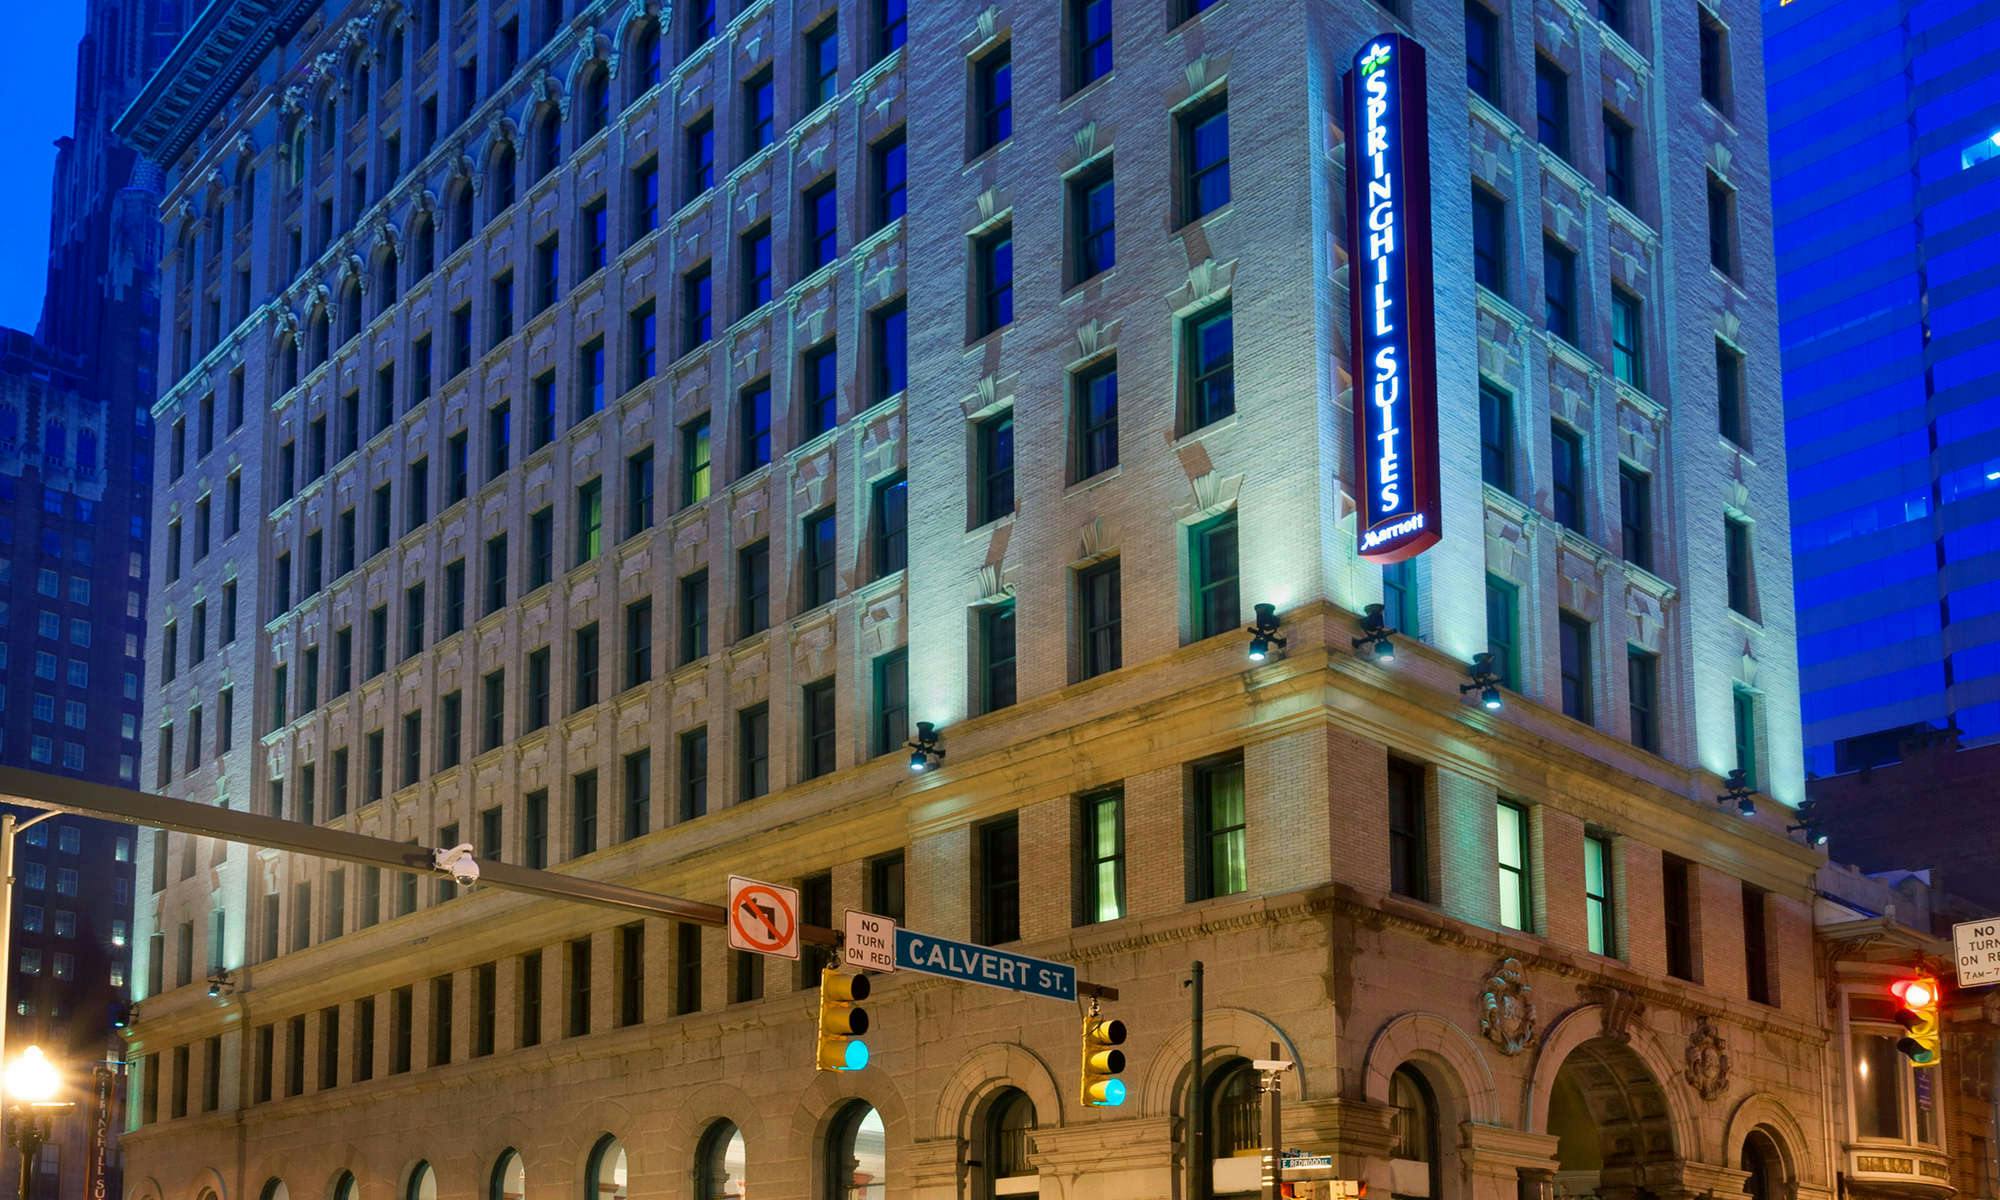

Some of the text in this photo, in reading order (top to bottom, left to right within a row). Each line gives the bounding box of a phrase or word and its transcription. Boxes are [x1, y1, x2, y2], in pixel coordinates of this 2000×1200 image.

[1366, 69, 1399, 512] SPRINGHILL SUITES
[1360, 513, 1423, 551] Marriott
[862, 920, 879, 933] NO
[1974, 926, 1995, 937] NO
[857, 934, 885, 949] TURN
[848, 947, 891, 965] ON RED
[909, 938, 1068, 992] CALVERT ST.
[1961, 955, 1978, 966] ON
[95, 1179, 105, 1200] SU
